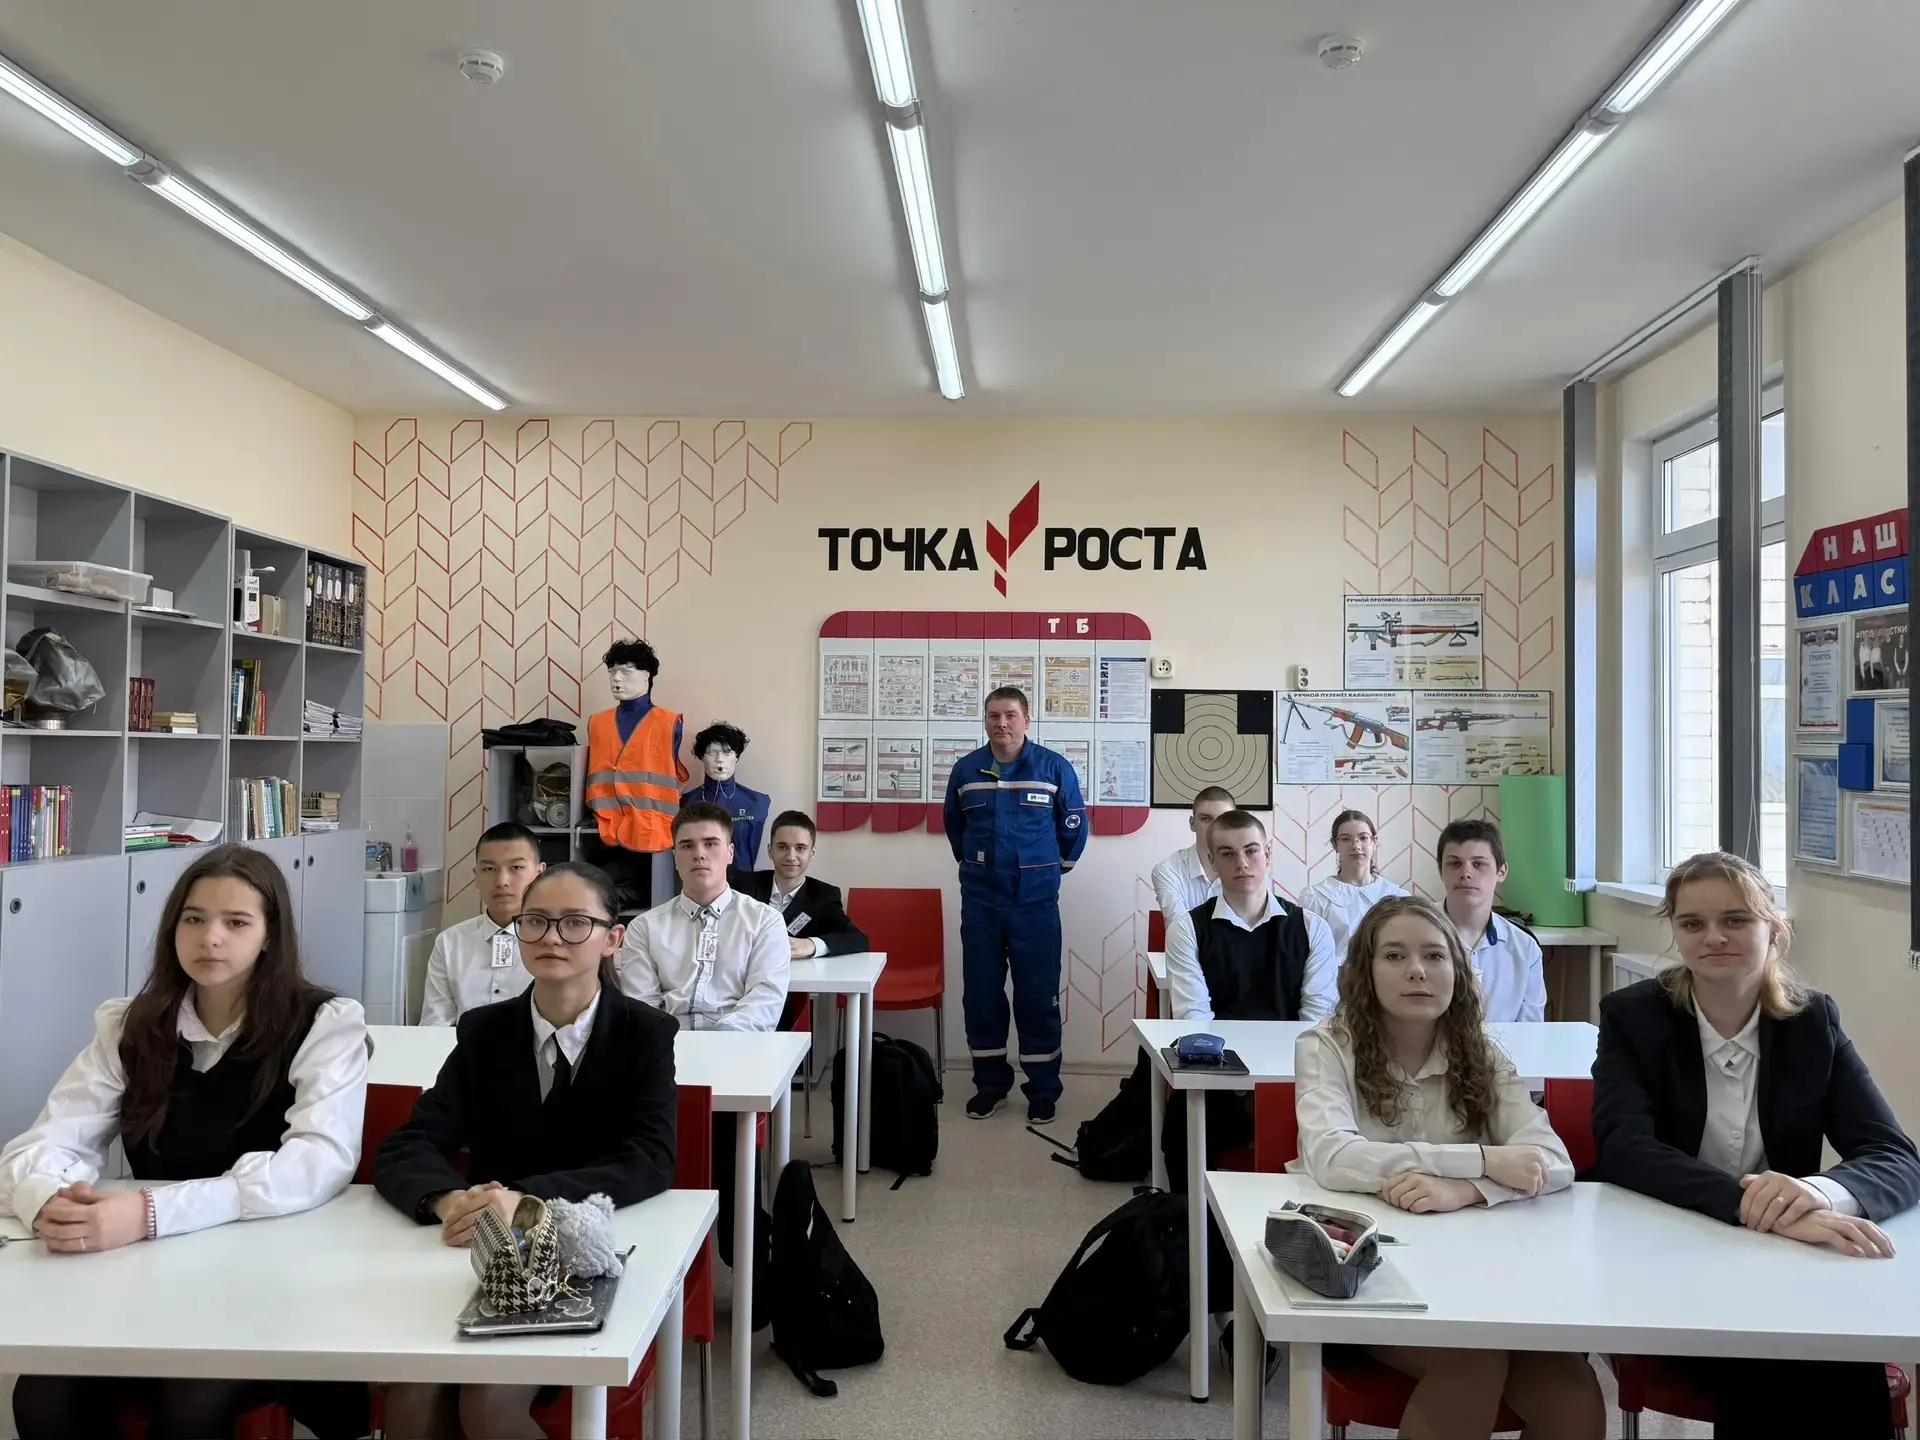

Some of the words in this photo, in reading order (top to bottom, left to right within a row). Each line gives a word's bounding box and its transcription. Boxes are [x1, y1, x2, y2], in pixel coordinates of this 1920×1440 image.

[818, 528, 978, 572] ТОЧКА
[1044, 527, 1207, 571] РОСТА
[1822, 522, 1897, 561] НАШ
